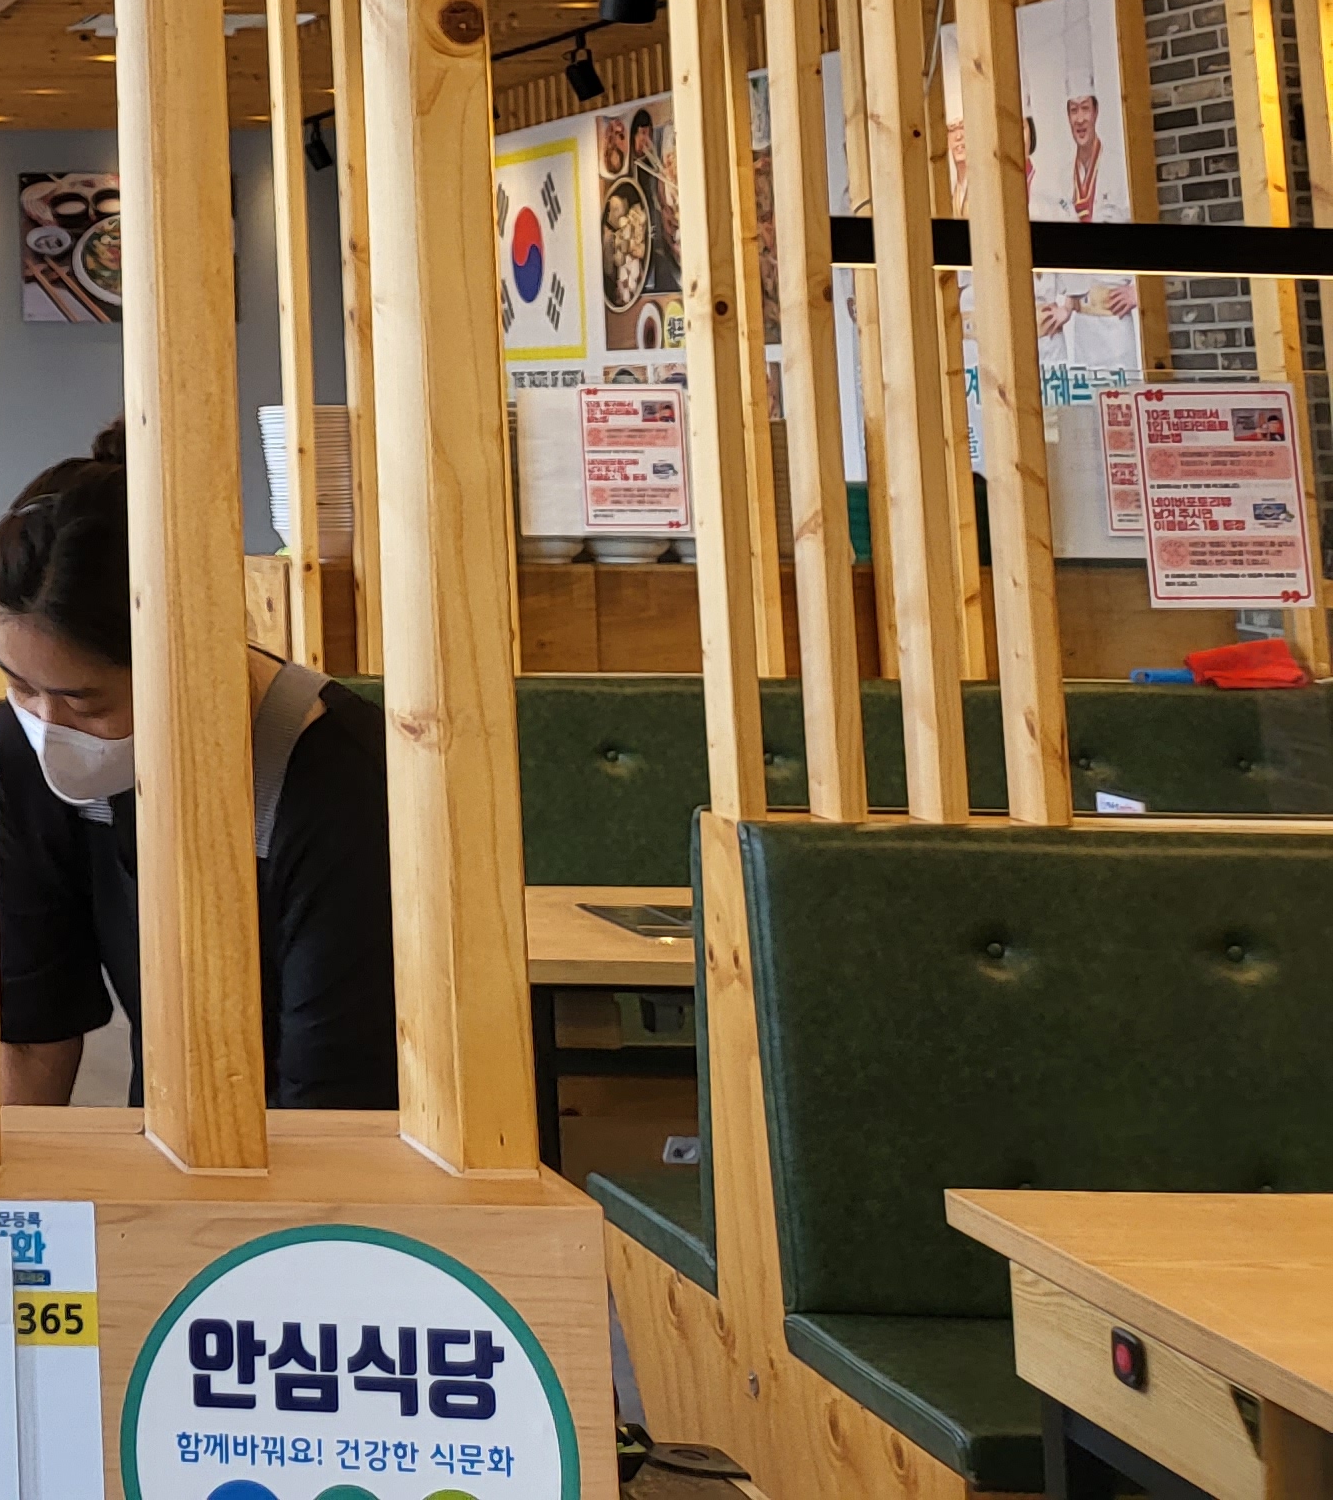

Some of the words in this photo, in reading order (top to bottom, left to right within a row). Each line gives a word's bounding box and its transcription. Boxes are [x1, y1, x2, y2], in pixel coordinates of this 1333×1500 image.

[16, 1302, 84, 1335] 365
[187, 1317, 506, 1421] 안심식당
[335, 1438, 420, 1474] 건강한
[429, 1442, 515, 1478] 식문화
